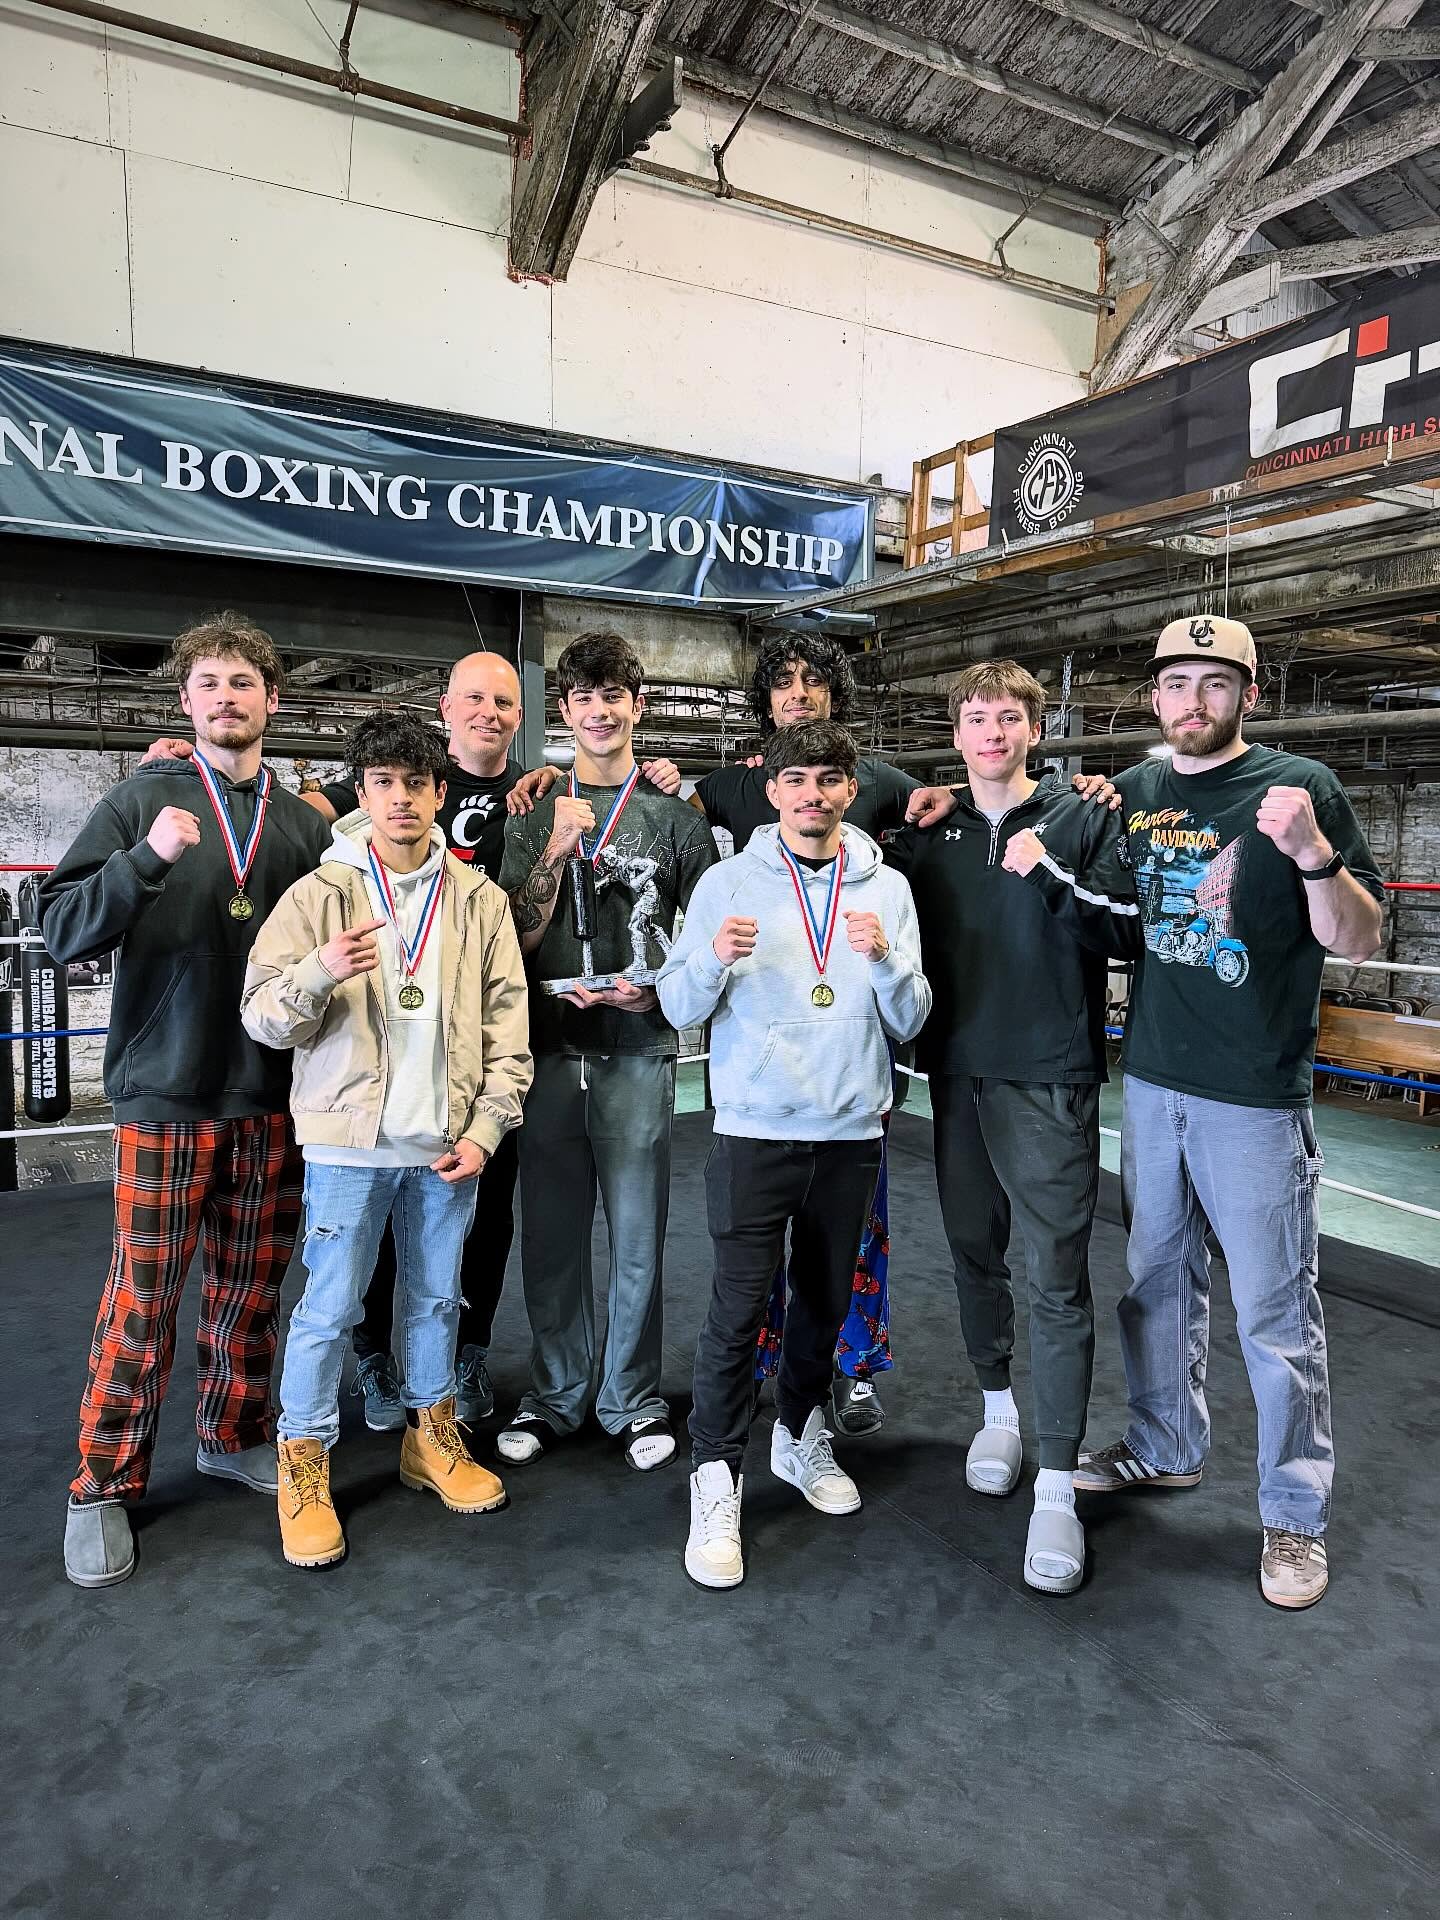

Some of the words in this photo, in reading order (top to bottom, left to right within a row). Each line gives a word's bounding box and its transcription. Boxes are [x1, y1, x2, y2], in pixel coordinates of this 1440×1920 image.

[1018, 433, 1077, 473] CINCINNATI
[1245, 435, 1350, 480] CINCINNATI
[0, 416, 143, 484] NAL
[161, 440, 431, 520] BOXING
[448, 483, 844, 576] CHAMPIONSHIP
[1013, 488, 1040, 534] FITNESS
[1049, 472, 1084, 529] BOXING
[1189, 620, 1215, 647] UC
[30, 968, 40, 983] THE
[42, 968, 56, 1032] COMBAT
[31, 1063, 41, 1078] THE
[42, 1037, 57, 1098] SPORTS
